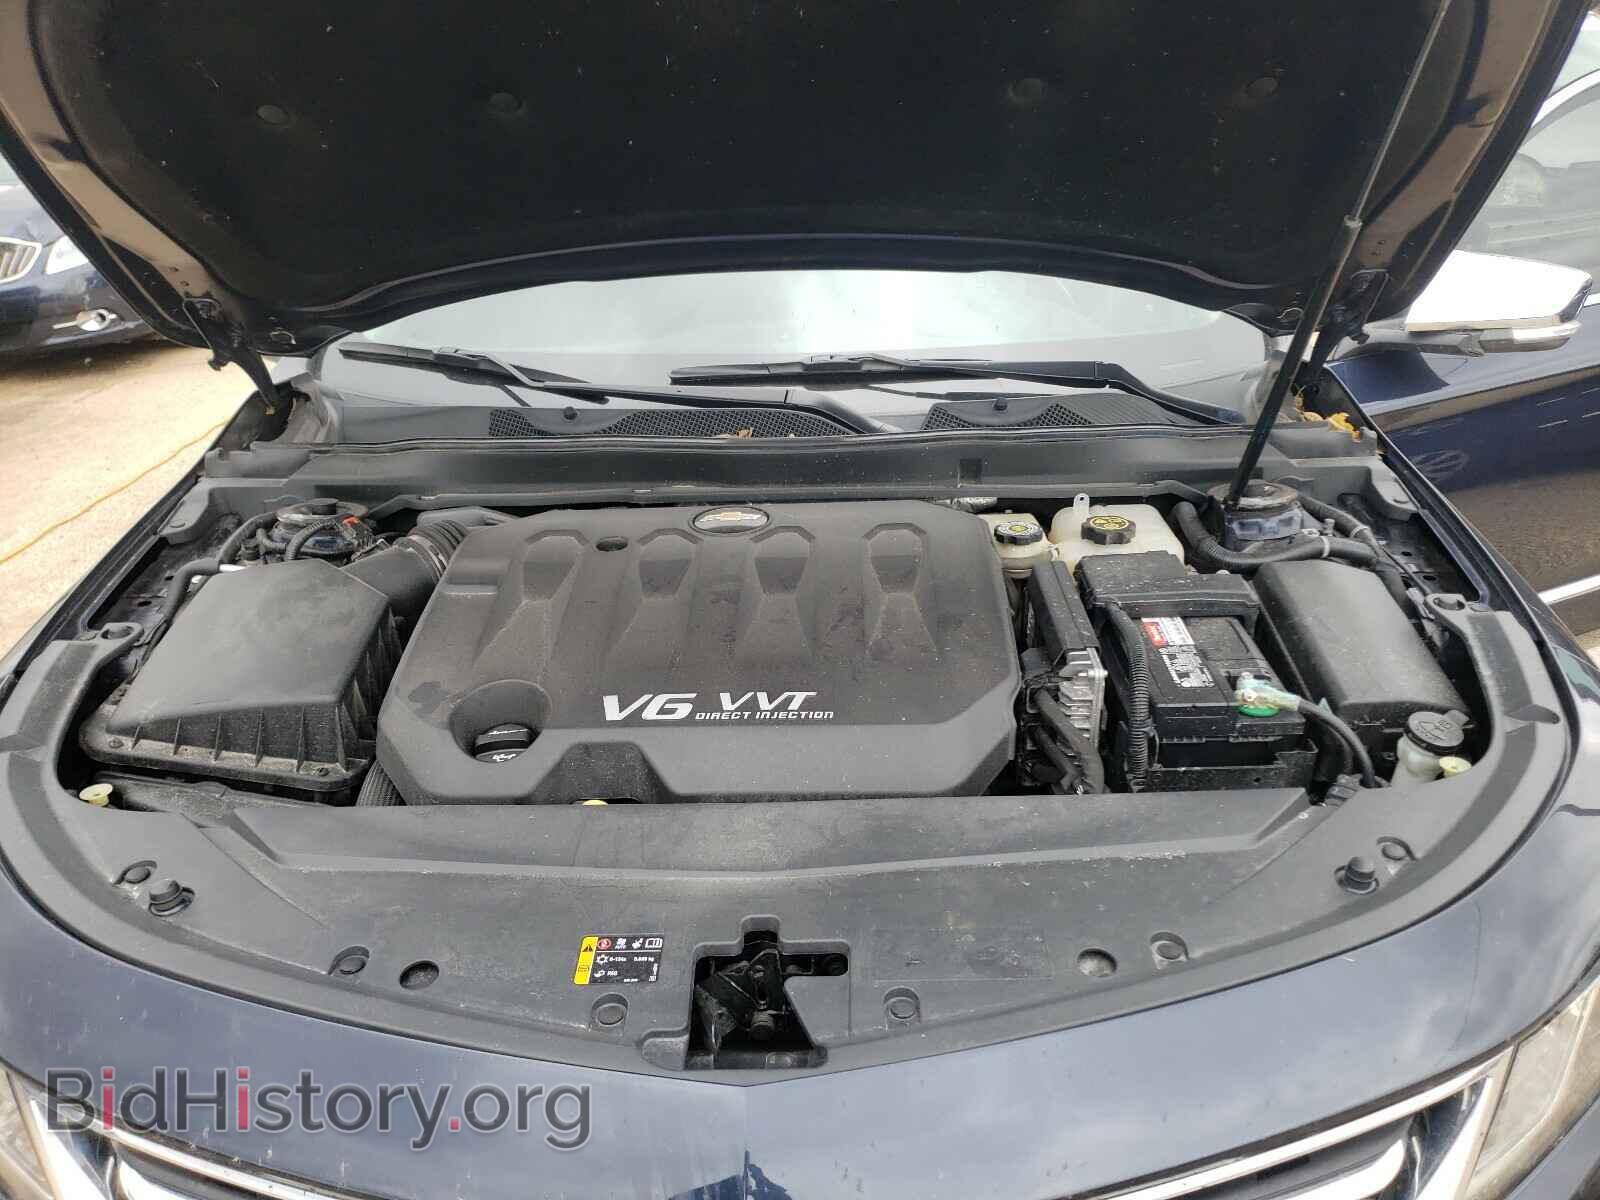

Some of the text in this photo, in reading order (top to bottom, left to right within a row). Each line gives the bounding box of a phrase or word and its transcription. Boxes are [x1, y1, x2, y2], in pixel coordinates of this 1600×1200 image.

[603, 691, 817, 720] V6 VVT
[695, 711, 834, 720] DIRECT INJECTION
